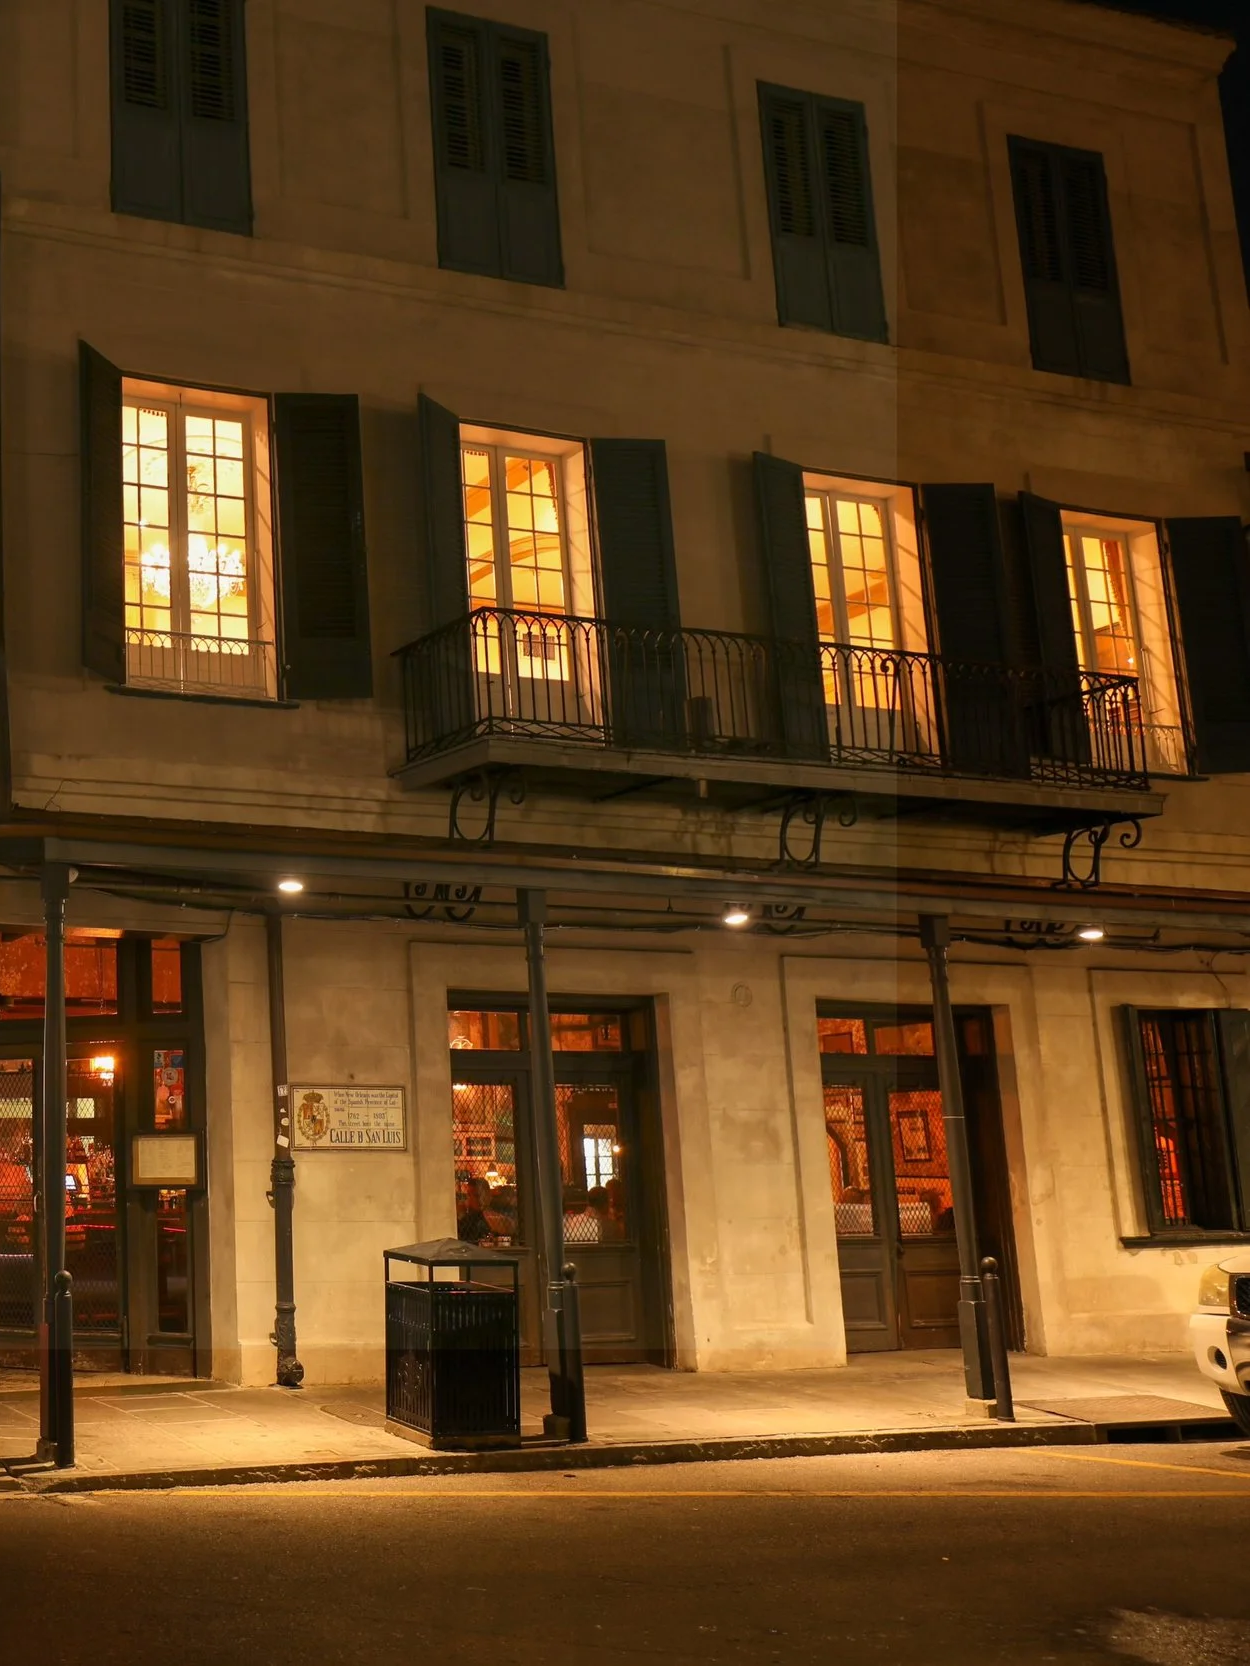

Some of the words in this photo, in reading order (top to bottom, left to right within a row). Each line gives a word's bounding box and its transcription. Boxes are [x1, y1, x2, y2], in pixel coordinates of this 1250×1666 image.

[330, 1128, 355, 1143] CALLE
[366, 1128, 381, 1143] SAN
[382, 1129, 401, 1143] LUIS
